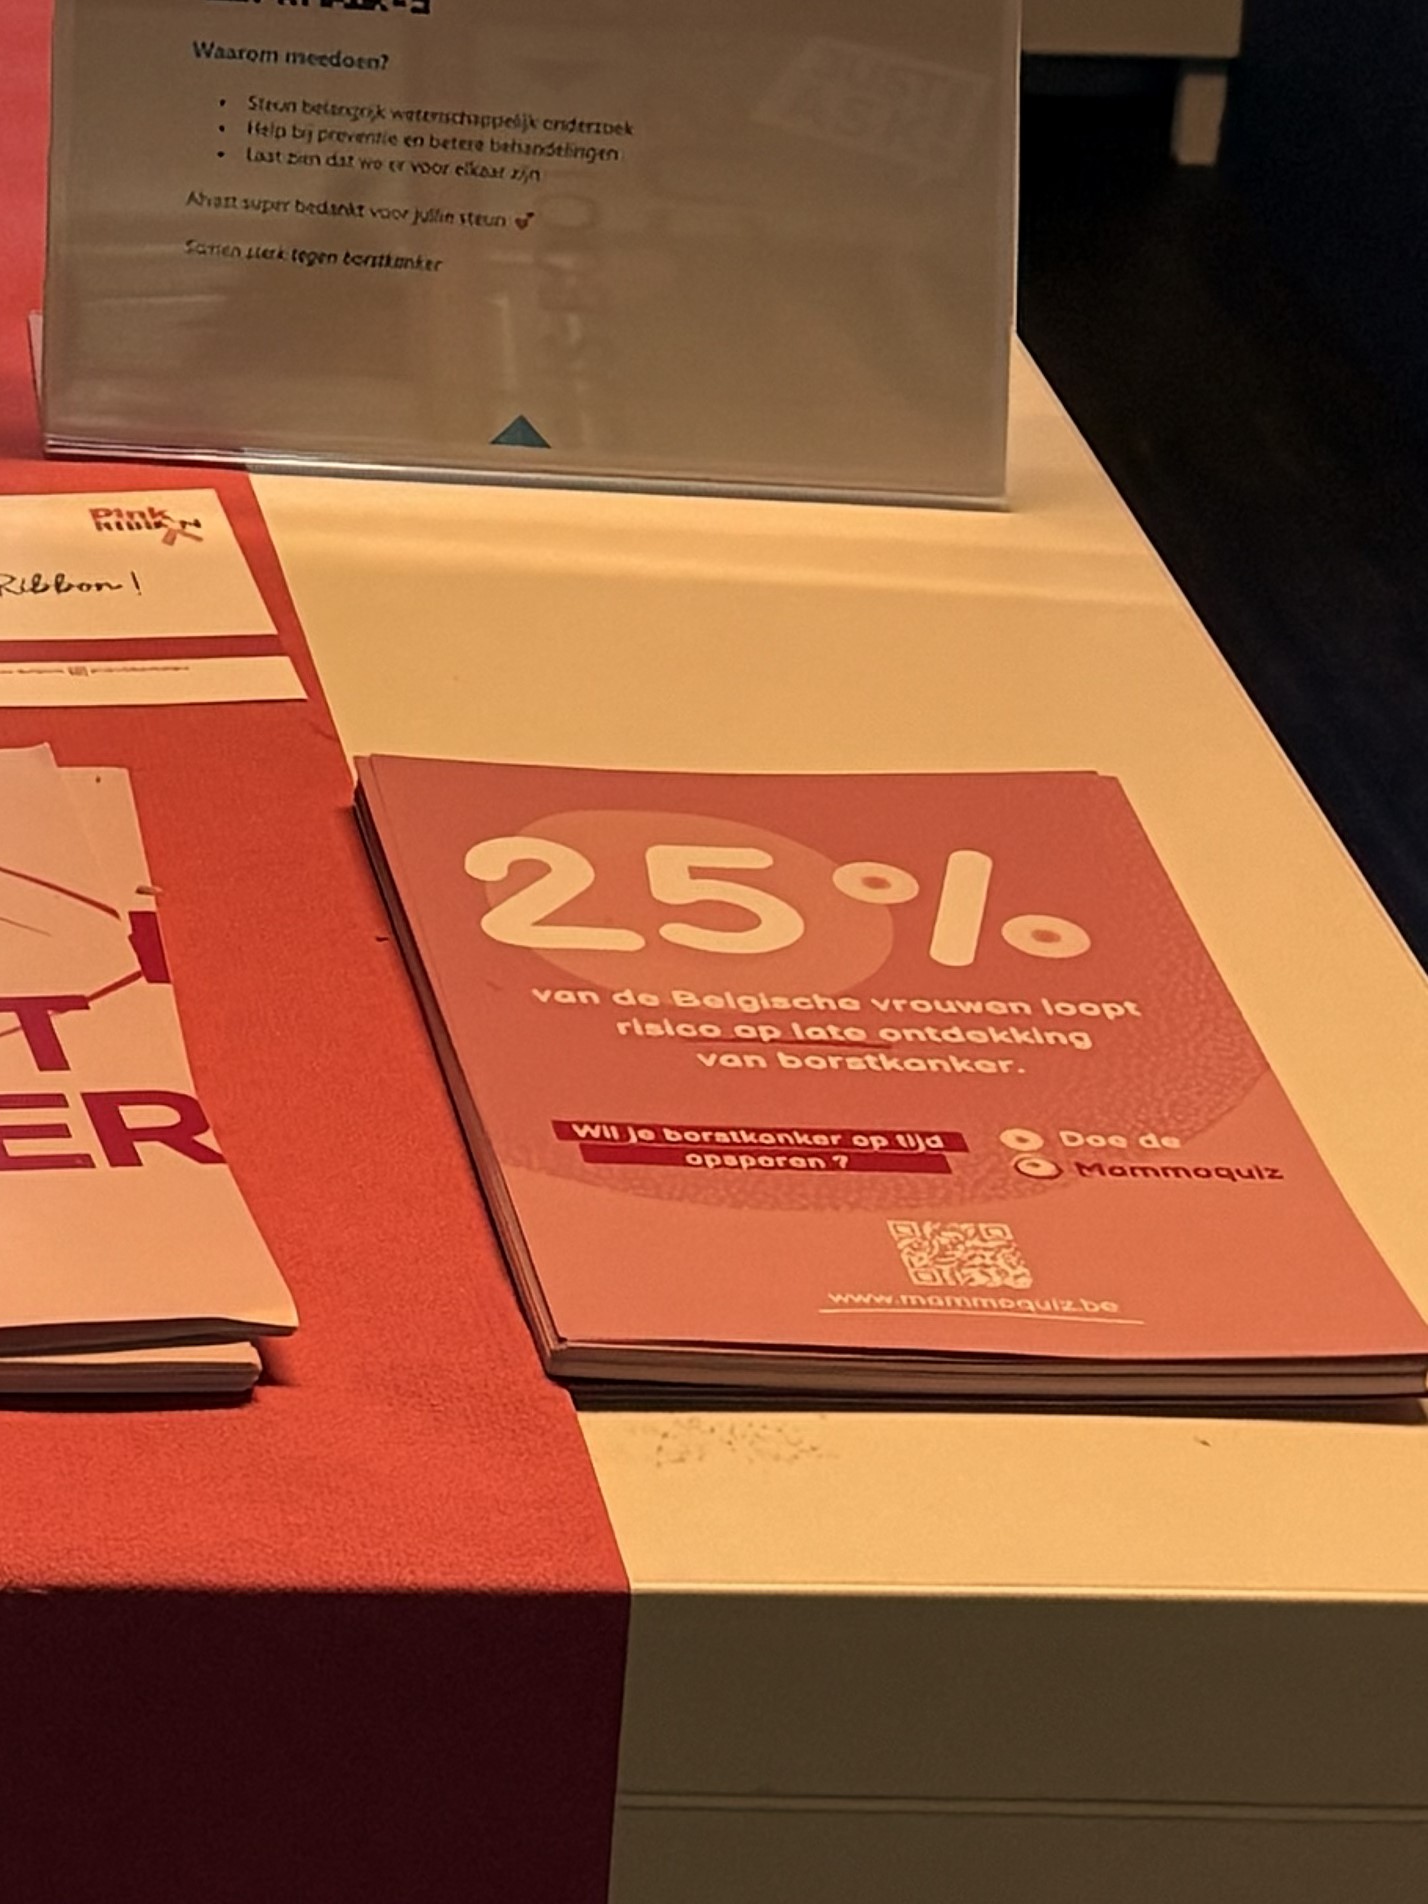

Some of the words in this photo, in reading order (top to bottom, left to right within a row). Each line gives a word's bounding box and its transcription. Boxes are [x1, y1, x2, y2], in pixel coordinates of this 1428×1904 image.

[192, 40, 279, 65] Waarom
[285, 51, 390, 73] meedoen?
[247, 95, 297, 114] Steun
[301, 99, 386, 122] belangrijk
[247, 120, 288, 140] Help
[292, 123, 314, 144] bij
[317, 127, 399, 149] preventie
[403, 133, 424, 148] en
[428, 133, 485, 153] betere
[489, 136, 620, 164] behandelingen
[246, 146, 282, 165] Laat
[326, 152, 355, 169] dat
[388, 160, 406, 173] er
[410, 160, 450, 177] voor
[454, 160, 506, 181] elkaar
[510, 165, 541, 184] zijn
[186, 191, 239, 210] Alvast
[243, 195, 291, 215] super
[295, 198, 365, 218] bedankt
[369, 206, 410, 221] voor
[460, 212, 507, 229] steun
[291, 247, 338, 268] tegen
[463, 835, 1092, 967] 25%
[532, 988, 600, 1005] van
[612, 990, 660, 1007] de
[672, 990, 861, 1013] Belgische
[871, 996, 1031, 1015] vrouwen
[1041, 996, 1142, 1020] loopt
[616, 1019, 721, 1038] risico
[734, 1022, 781, 1043] op
[791, 1021, 866, 1041] late
[878, 1025, 1094, 1051] ontdekking
[696, 1051, 767, 1069] van
[777, 1051, 1026, 1074] borstkanker.
[571, 1123, 619, 1141] Wil
[627, 1125, 657, 1146] je
[663, 1127, 843, 1149] borstkanker
[852, 1132, 891, 1152] op
[897, 1130, 945, 1153] tijd
[1059, 1130, 1129, 1150] Doe
[1138, 1130, 1182, 1150] de
[684, 1150, 825, 1170] opsporen
[1075, 1159, 1284, 1183] Mammoquiz
[827, 1291, 1120, 1314] www.mammoquiz.be
